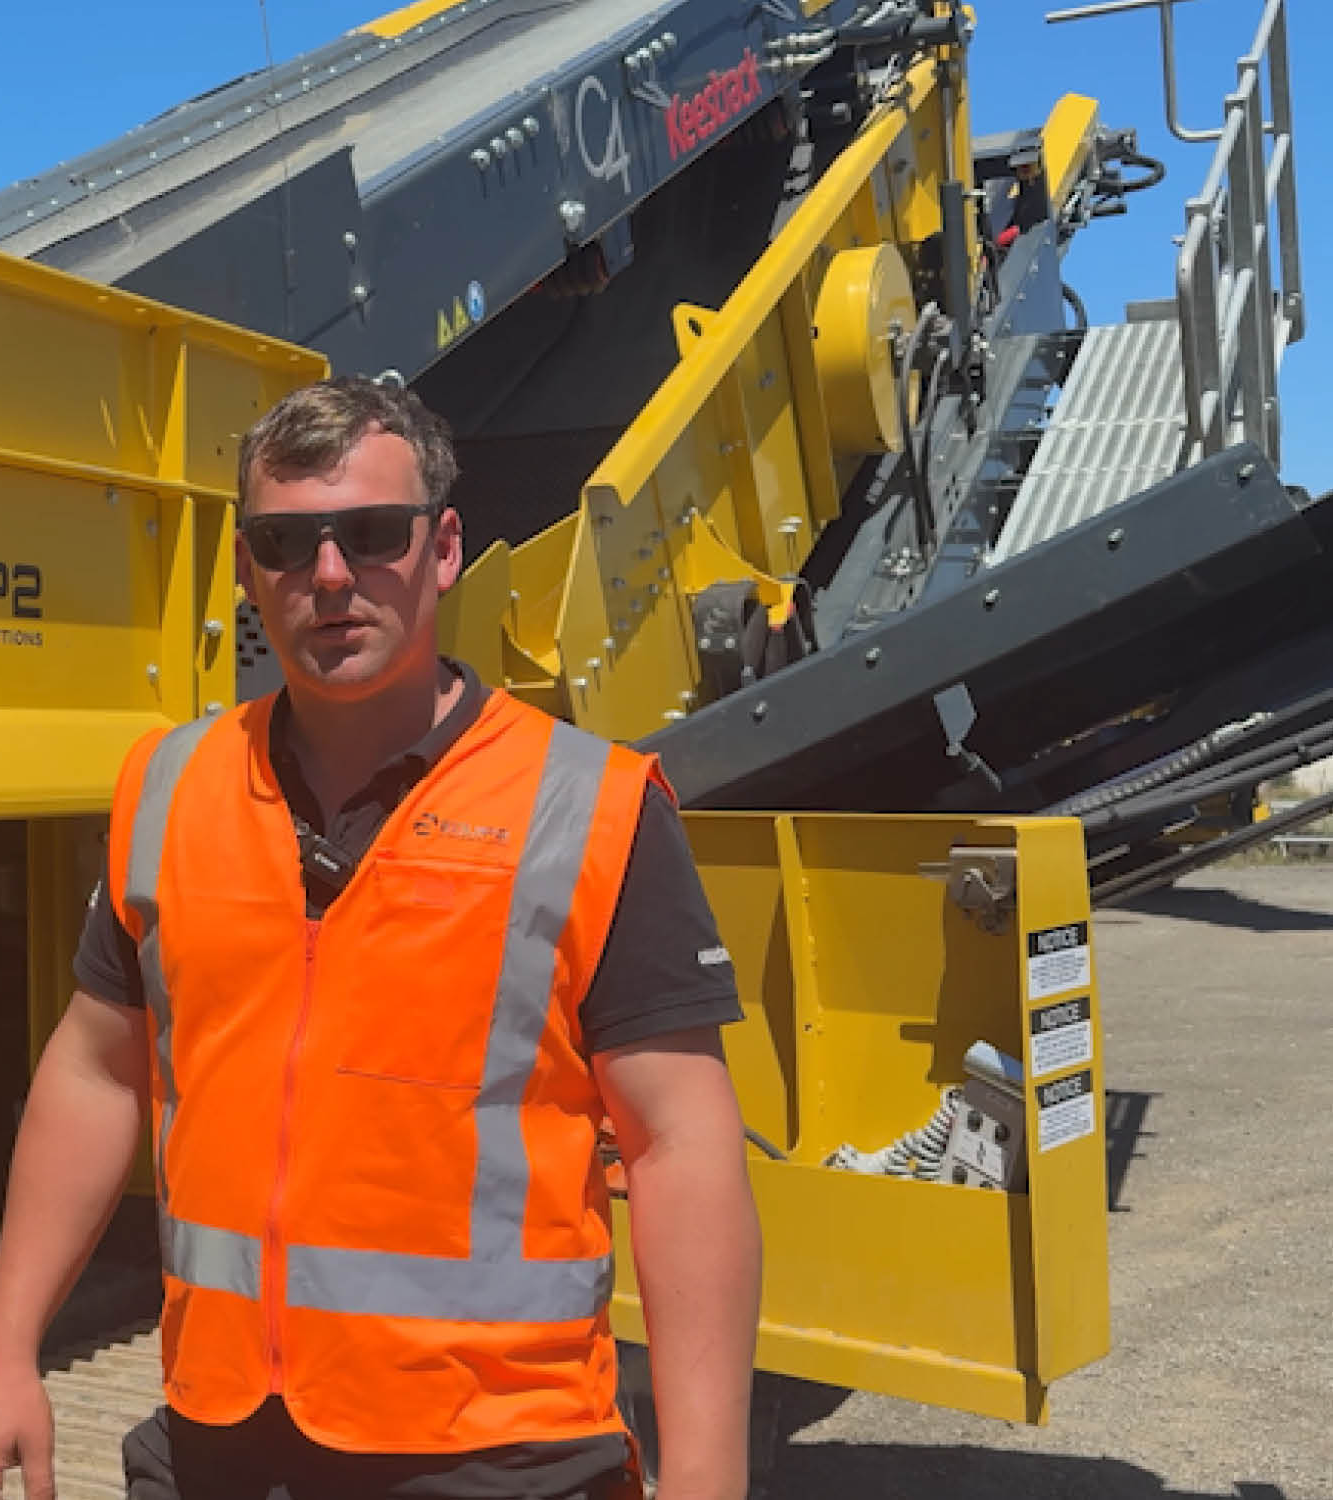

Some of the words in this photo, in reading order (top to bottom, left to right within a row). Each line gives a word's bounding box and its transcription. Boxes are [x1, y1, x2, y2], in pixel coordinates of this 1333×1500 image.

[664, 47, 762, 161] Keestrack
[574, 75, 631, 193] C4
[1037, 926, 1079, 952] NOTICE
[1040, 1002, 1080, 1029] NOTICE
[1043, 1075, 1082, 1107] NOTICE
